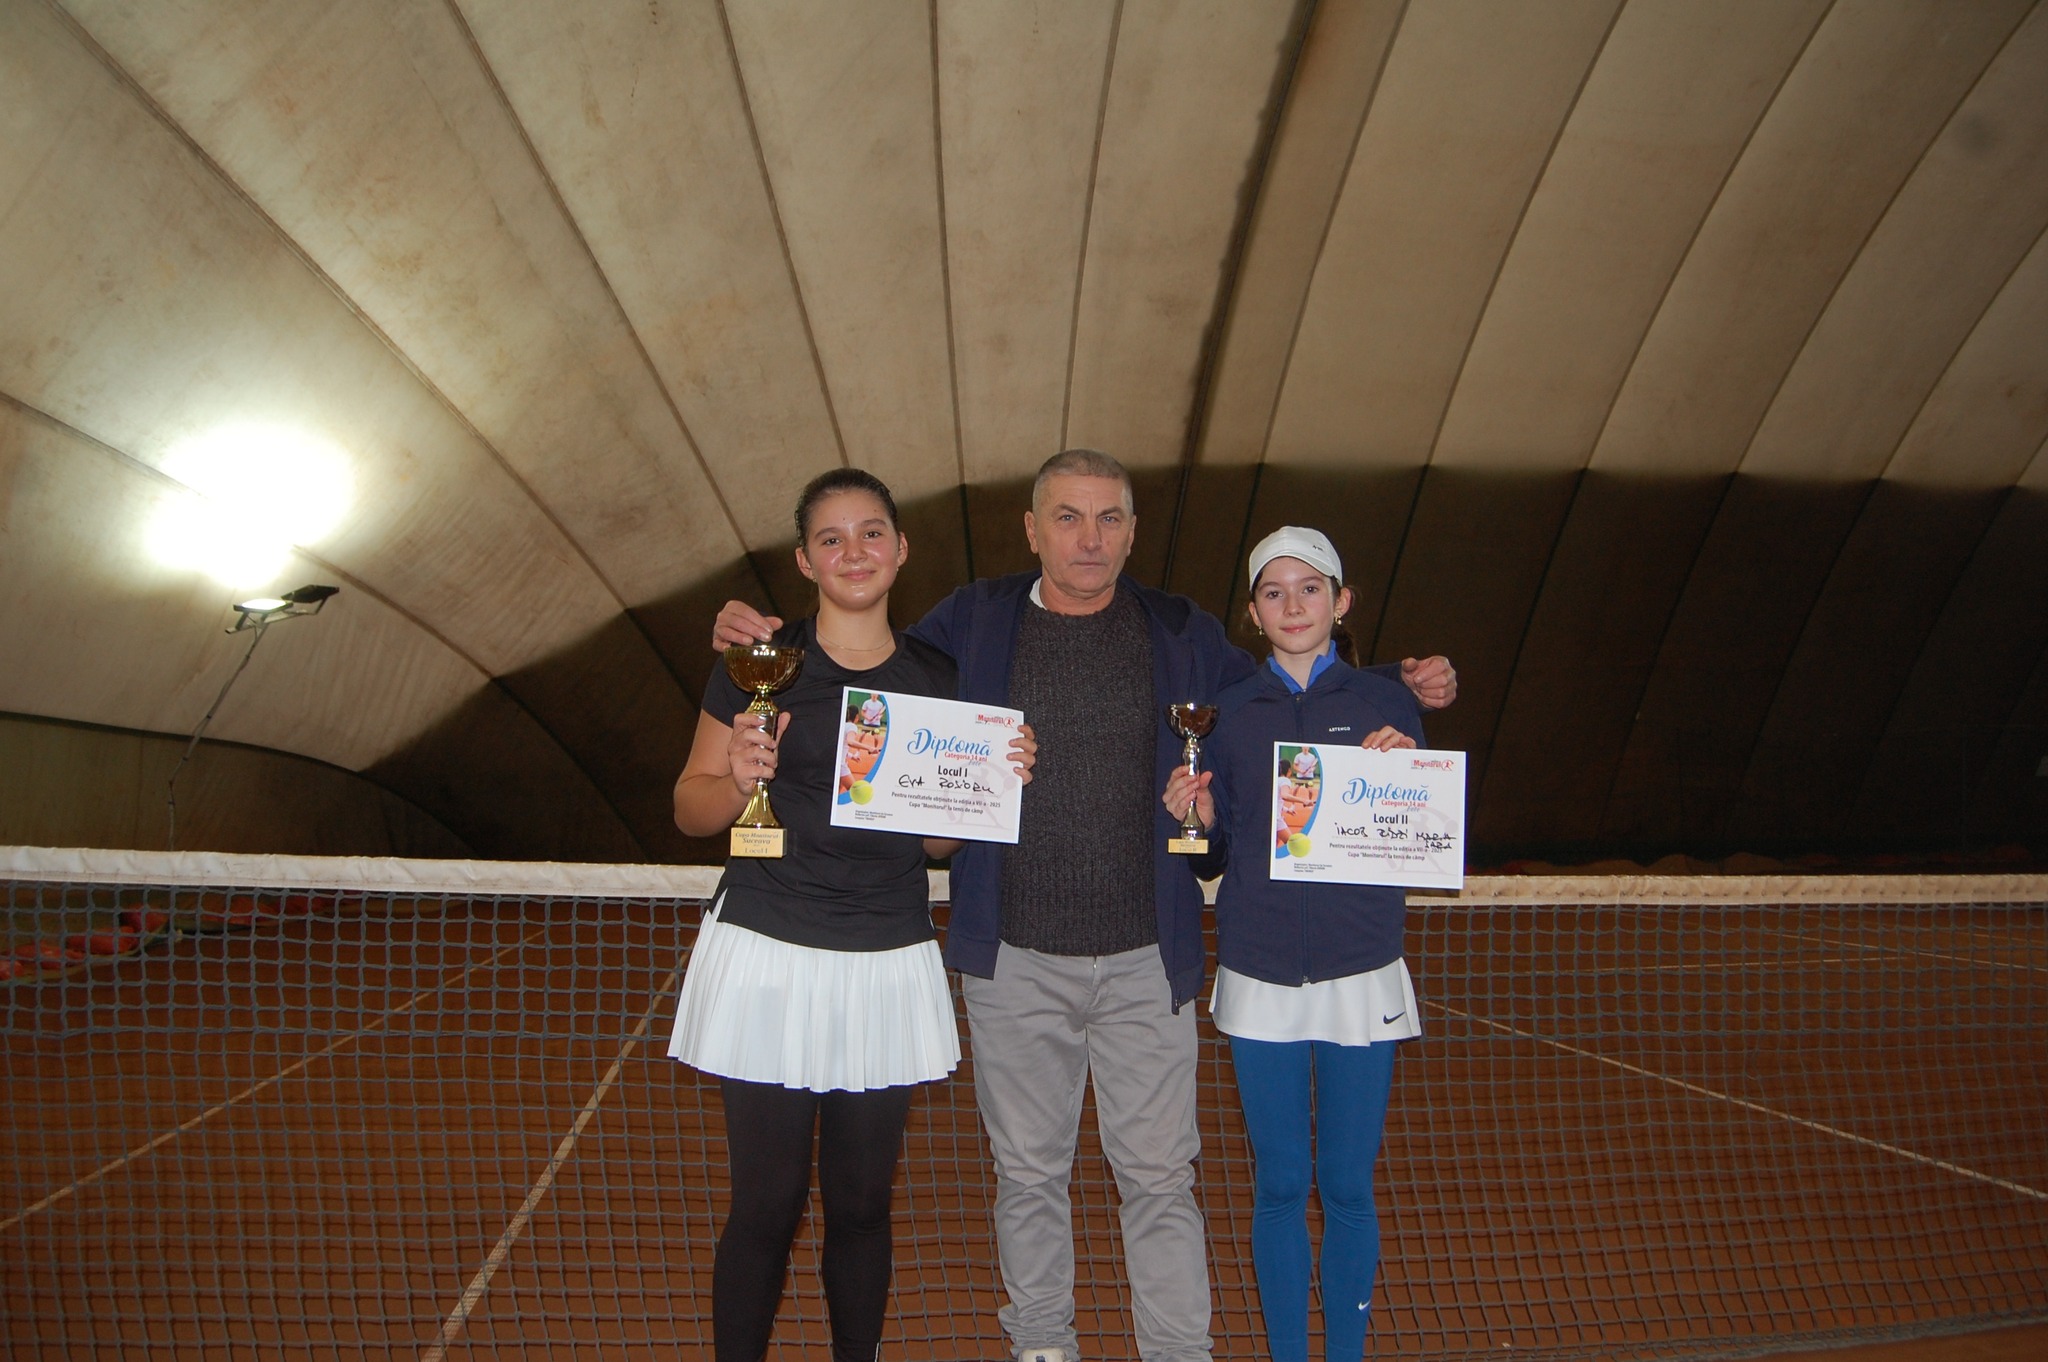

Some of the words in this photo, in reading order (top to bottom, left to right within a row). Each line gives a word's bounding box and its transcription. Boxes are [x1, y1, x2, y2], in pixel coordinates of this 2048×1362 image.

[907, 728, 993, 759] Diplomă
[944, 752, 970, 761] Categoria
[938, 765, 962, 777] Locul
[965, 768, 968, 777] I
[1342, 778, 1431, 808] Diplomă
[1374, 814, 1398, 824] Locul
[1402, 815, 1408, 824] II
